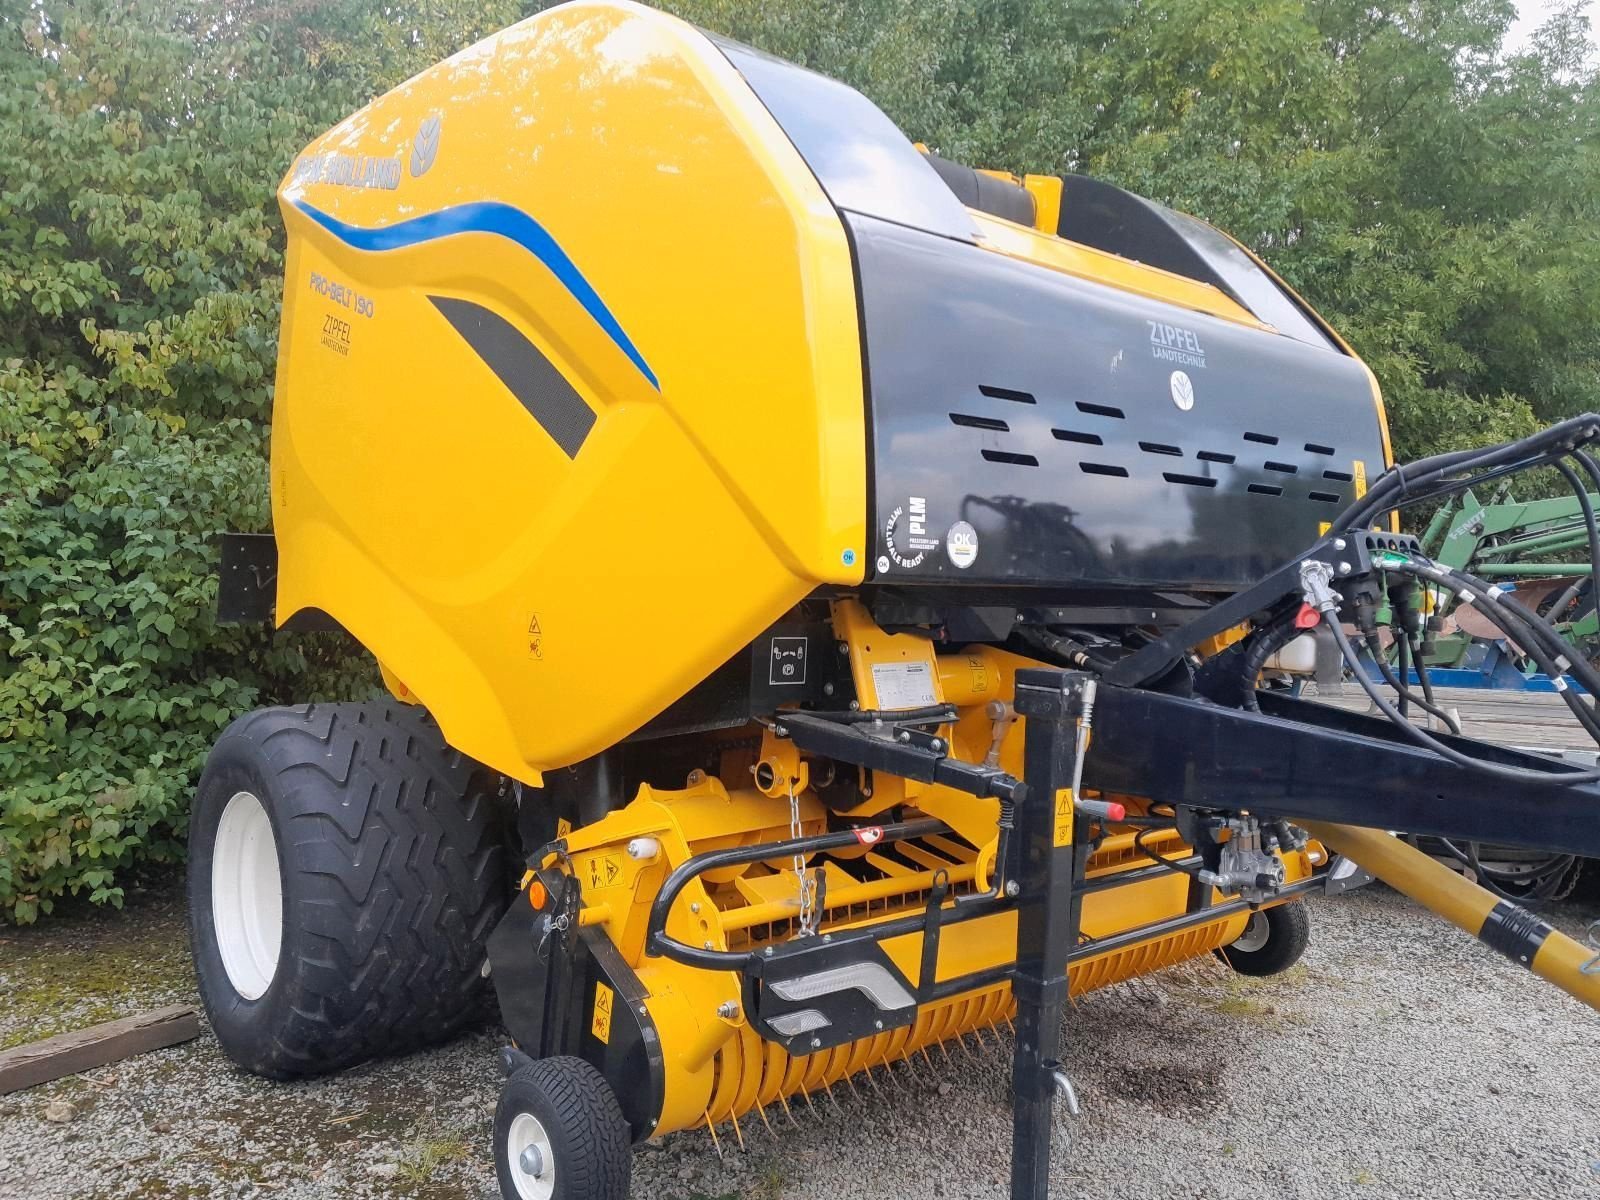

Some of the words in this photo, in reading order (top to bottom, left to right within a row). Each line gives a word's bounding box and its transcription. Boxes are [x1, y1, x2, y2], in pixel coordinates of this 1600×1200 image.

[324, 156, 402, 190] HOLLAND
[309, 272, 353, 308] PRO-BELT
[353, 293, 375, 318] 190
[323, 314, 351, 344] ZIPFEL
[1147, 320, 1205, 353] ZIPFEL
[1152, 346, 1207, 369] LANDTECHNIK
[909, 496, 926, 535] PLM
[885, 506, 903, 565] INTELLIBALE
[902, 551, 925, 569] READY
[954, 533, 971, 546] OK
[843, 553, 854, 561] OK
[878, 560, 889, 568] OK
